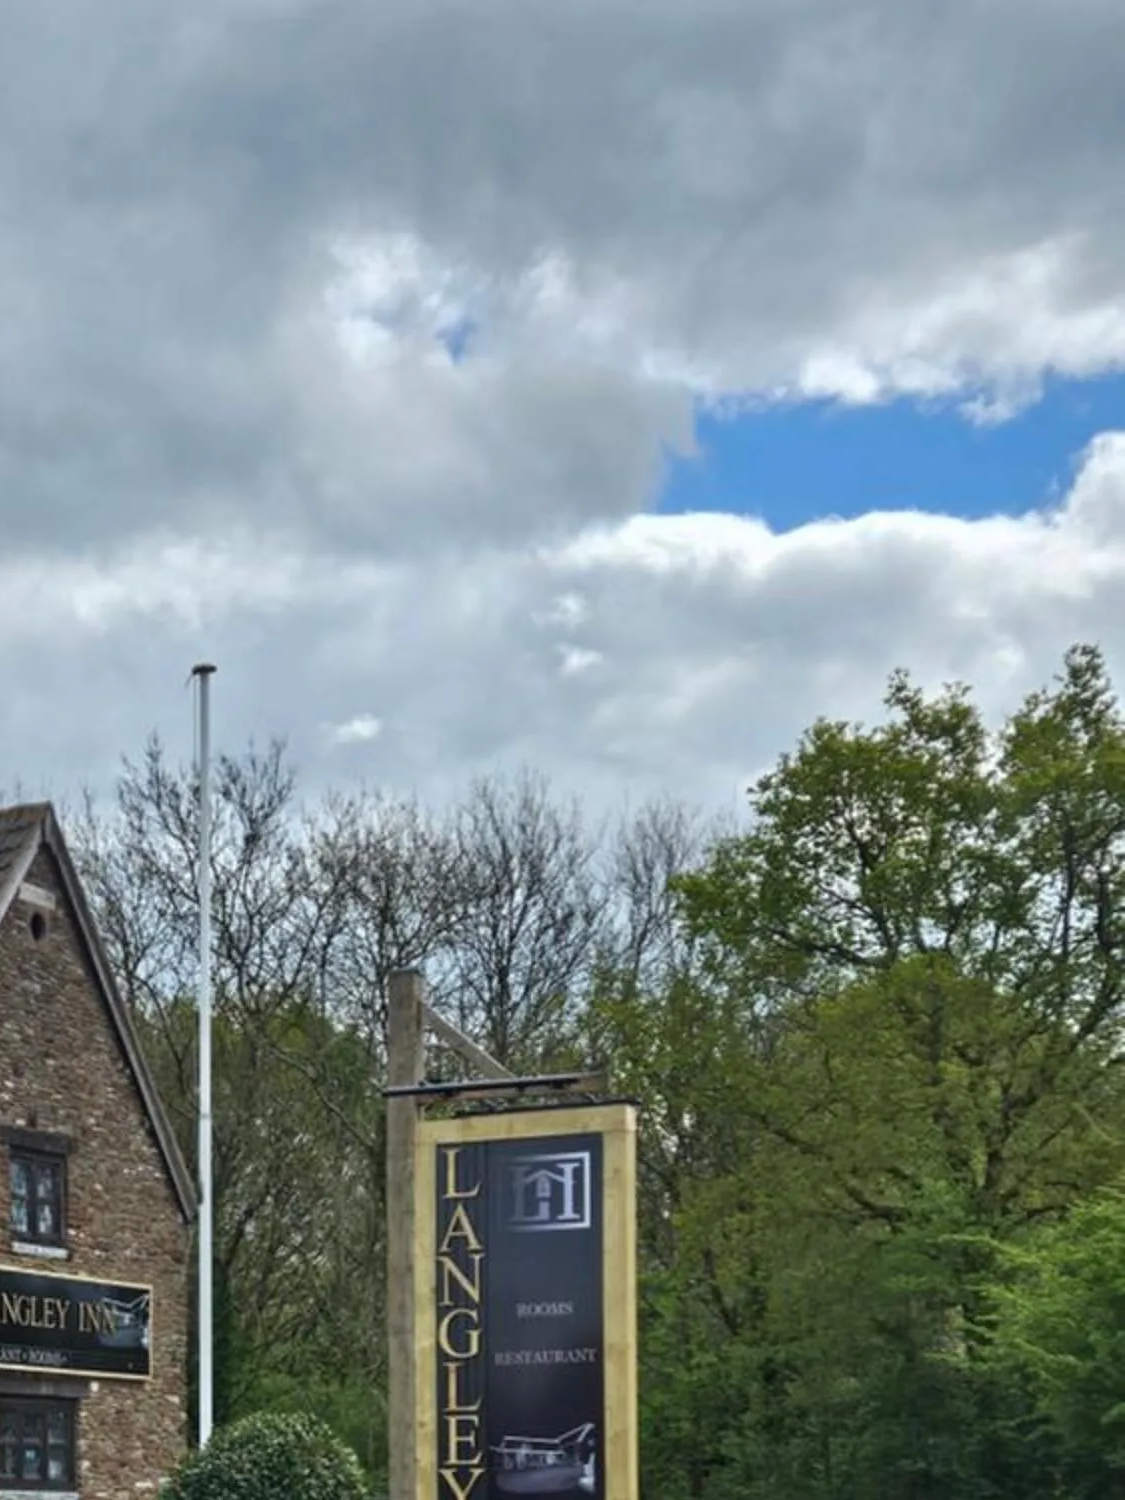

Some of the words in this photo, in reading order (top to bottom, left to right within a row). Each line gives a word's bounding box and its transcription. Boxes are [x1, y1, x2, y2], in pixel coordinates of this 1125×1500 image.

[78, 1301, 117, 1335] INN
[516, 1302, 573, 1318] ROOMS
[494, 1348, 597, 1365] RESTAURANT
